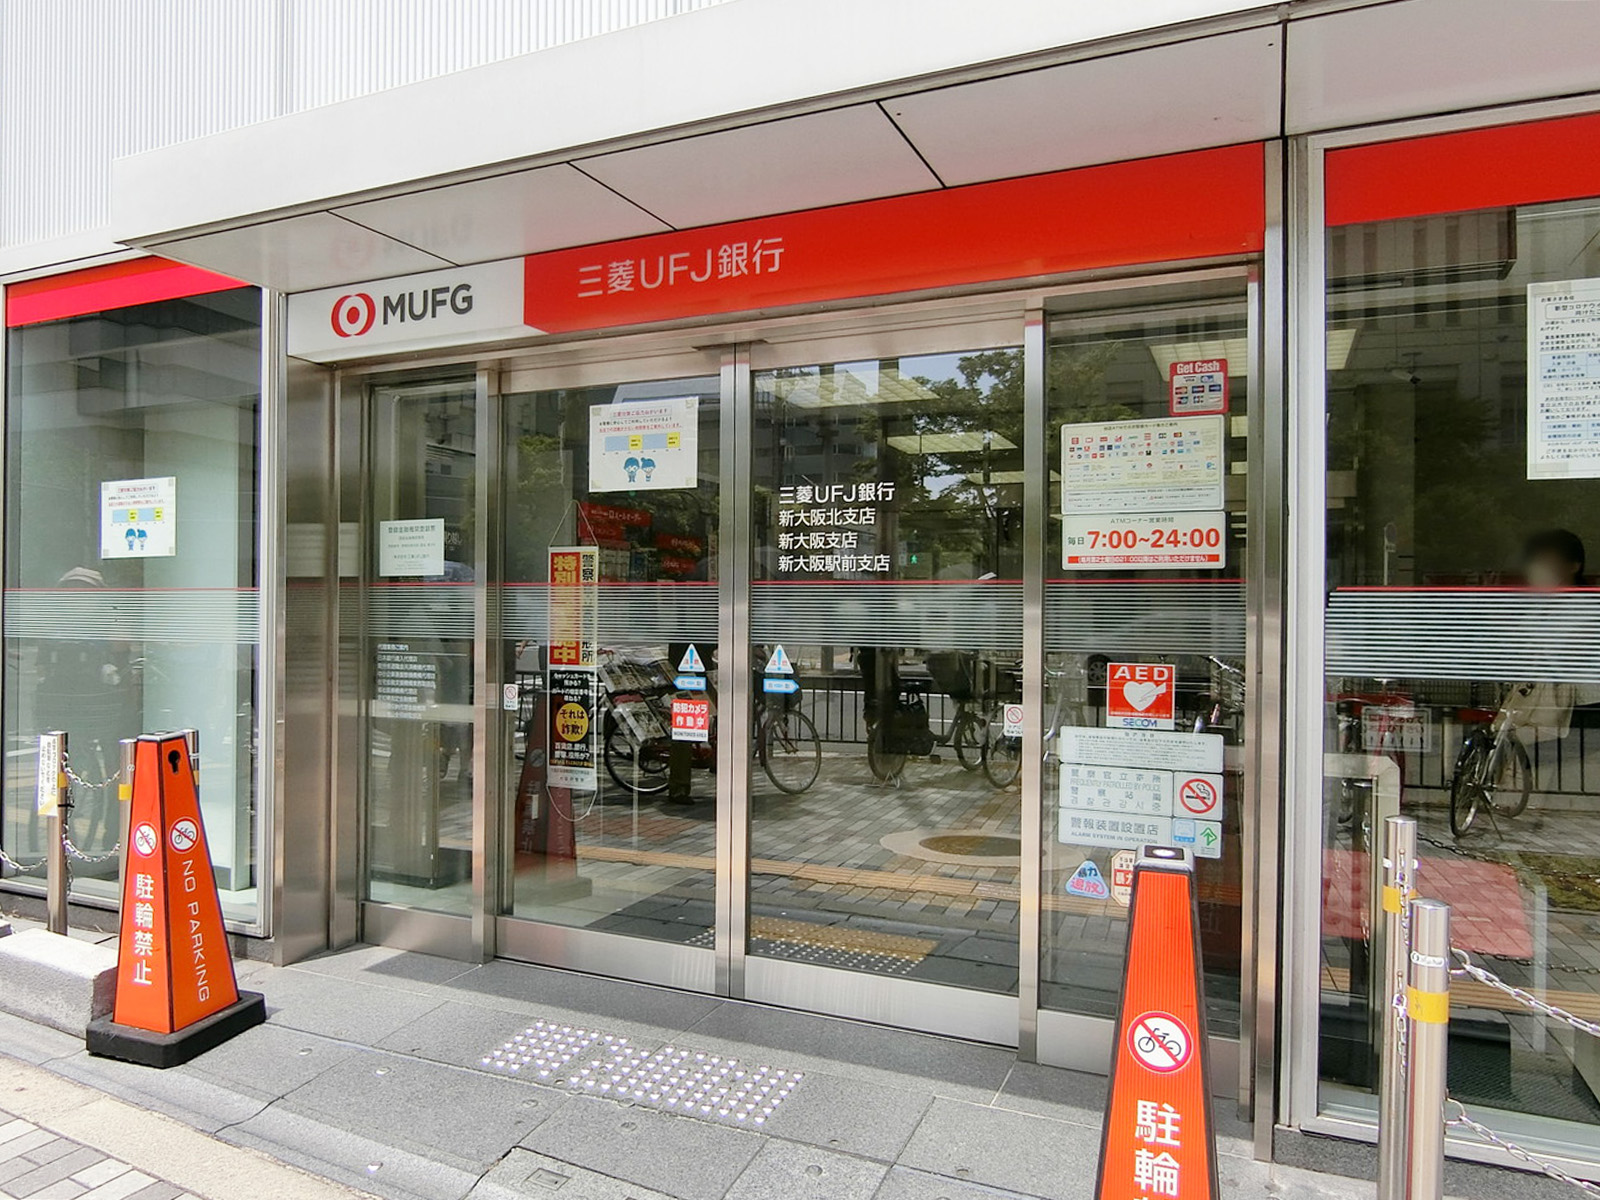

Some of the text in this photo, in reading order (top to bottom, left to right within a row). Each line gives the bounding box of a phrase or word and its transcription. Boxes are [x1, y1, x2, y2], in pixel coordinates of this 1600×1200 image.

[577, 237, 785, 298] 三菱UFJ銀行
[383, 283, 473, 325] MUFG
[1176, 360, 1220, 375] Get Cash
[779, 482, 896, 504] 三菱UFJ銀行
[778, 506, 876, 527] 新大阪北支店
[778, 531, 858, 550] 新大阪支店
[1067, 536, 1085, 546] 毎日
[778, 554, 891, 572] 新大阪駅前支店
[1113, 665, 1169, 681] AED
[560, 708, 585, 720] それは
[673, 702, 708, 714] 防犯カメラ
[676, 715, 704, 727] 作動中
[1122, 717, 1158, 728] SECOM
[1070, 777, 1101, 787] FREQUENTLY
[1103, 780, 1133, 790] PATROLLED
[1142, 783, 1161, 792] POLICE
[1071, 816, 1159, 835] 警報装置設置店
[1124, 836, 1158, 844] OPERATION
[134, 873, 155, 986] 駐輪禁止
[182, 859, 210, 1002] NO PARKING
[1133, 1099, 1182, 1200] 駐輪
